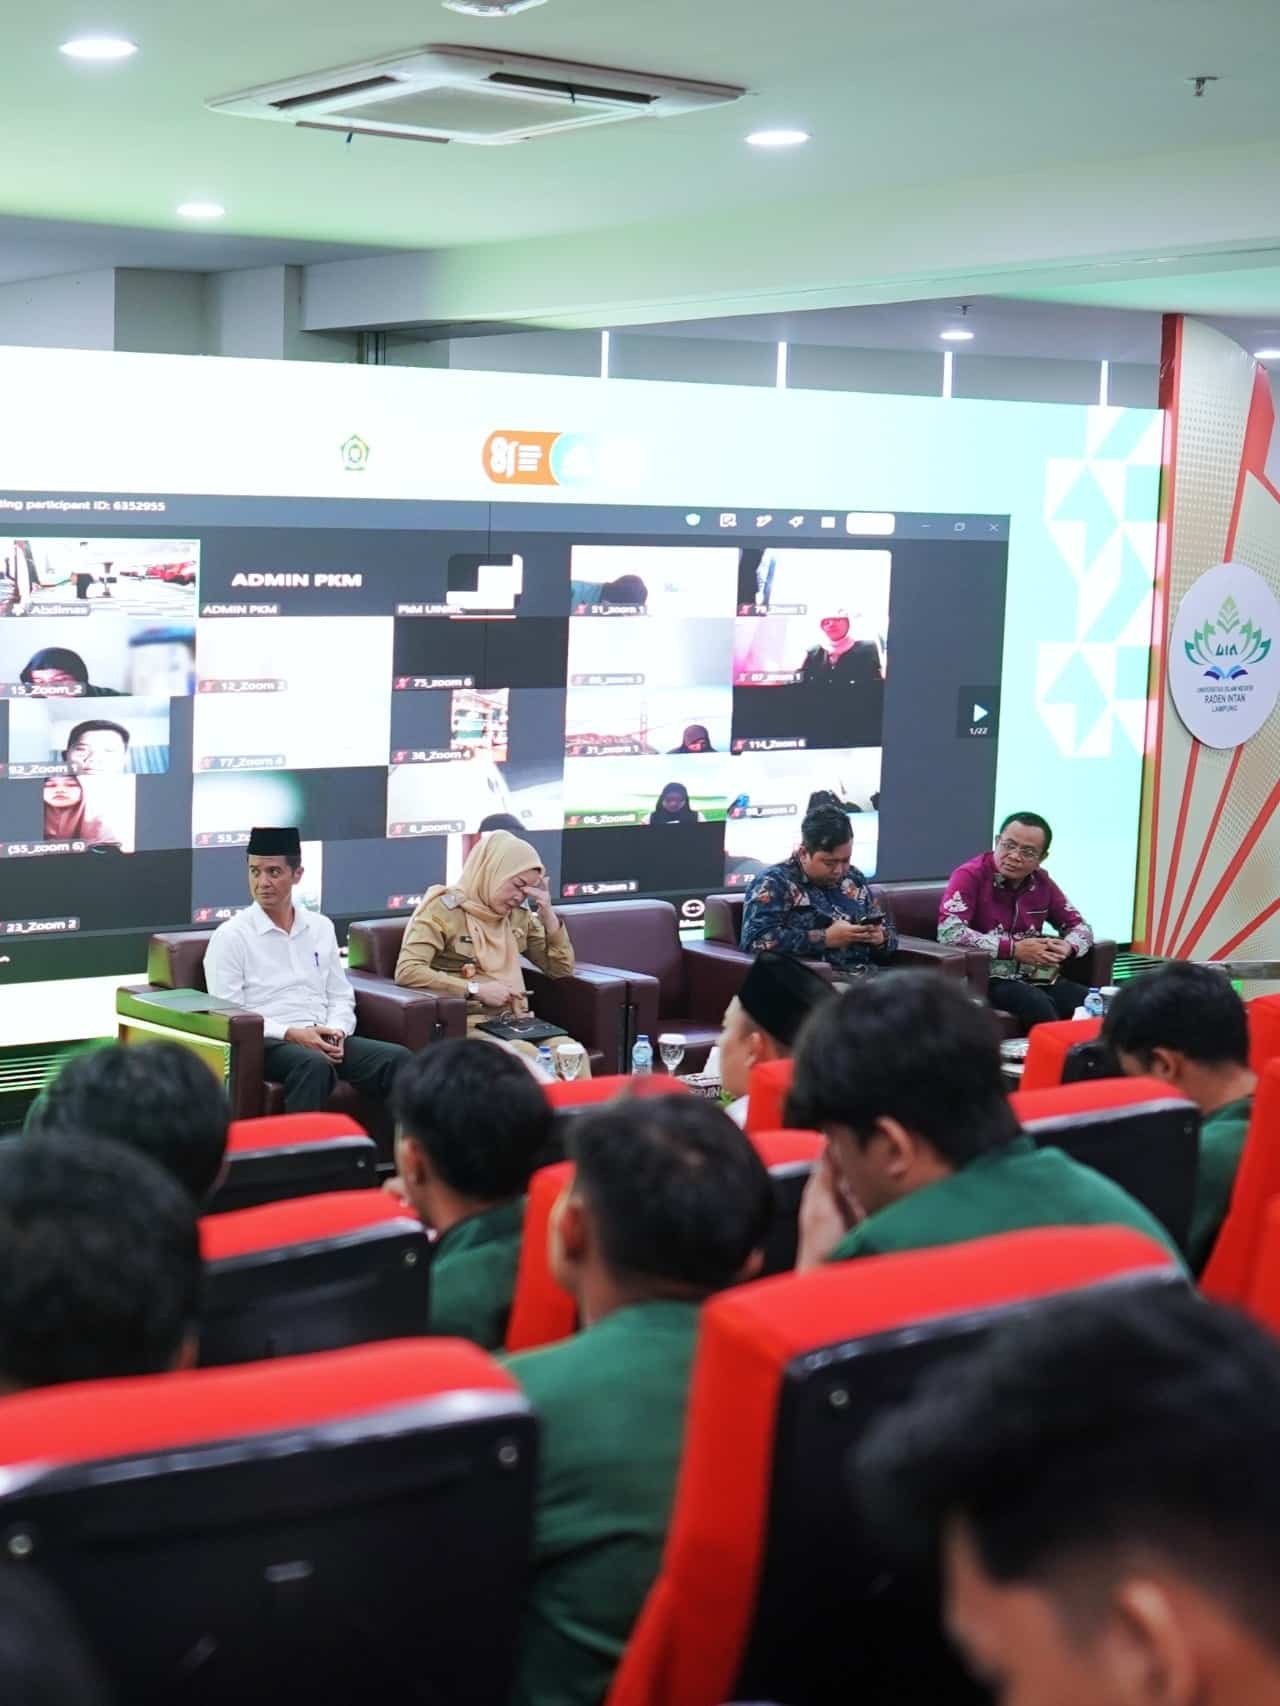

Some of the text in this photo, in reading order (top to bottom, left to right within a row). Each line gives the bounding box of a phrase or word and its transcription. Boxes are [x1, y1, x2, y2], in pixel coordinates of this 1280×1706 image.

[26, 499, 91, 512] participant
[93, 501, 111, 511] ID:
[113, 501, 166, 512] 6352955
[231, 572, 363, 588] ADMIN PKM
[30, 604, 87, 615] Abdimas
[202, 604, 278, 614] ADMIN PKM
[1204, 694, 1246, 704] RADEN INTAN
